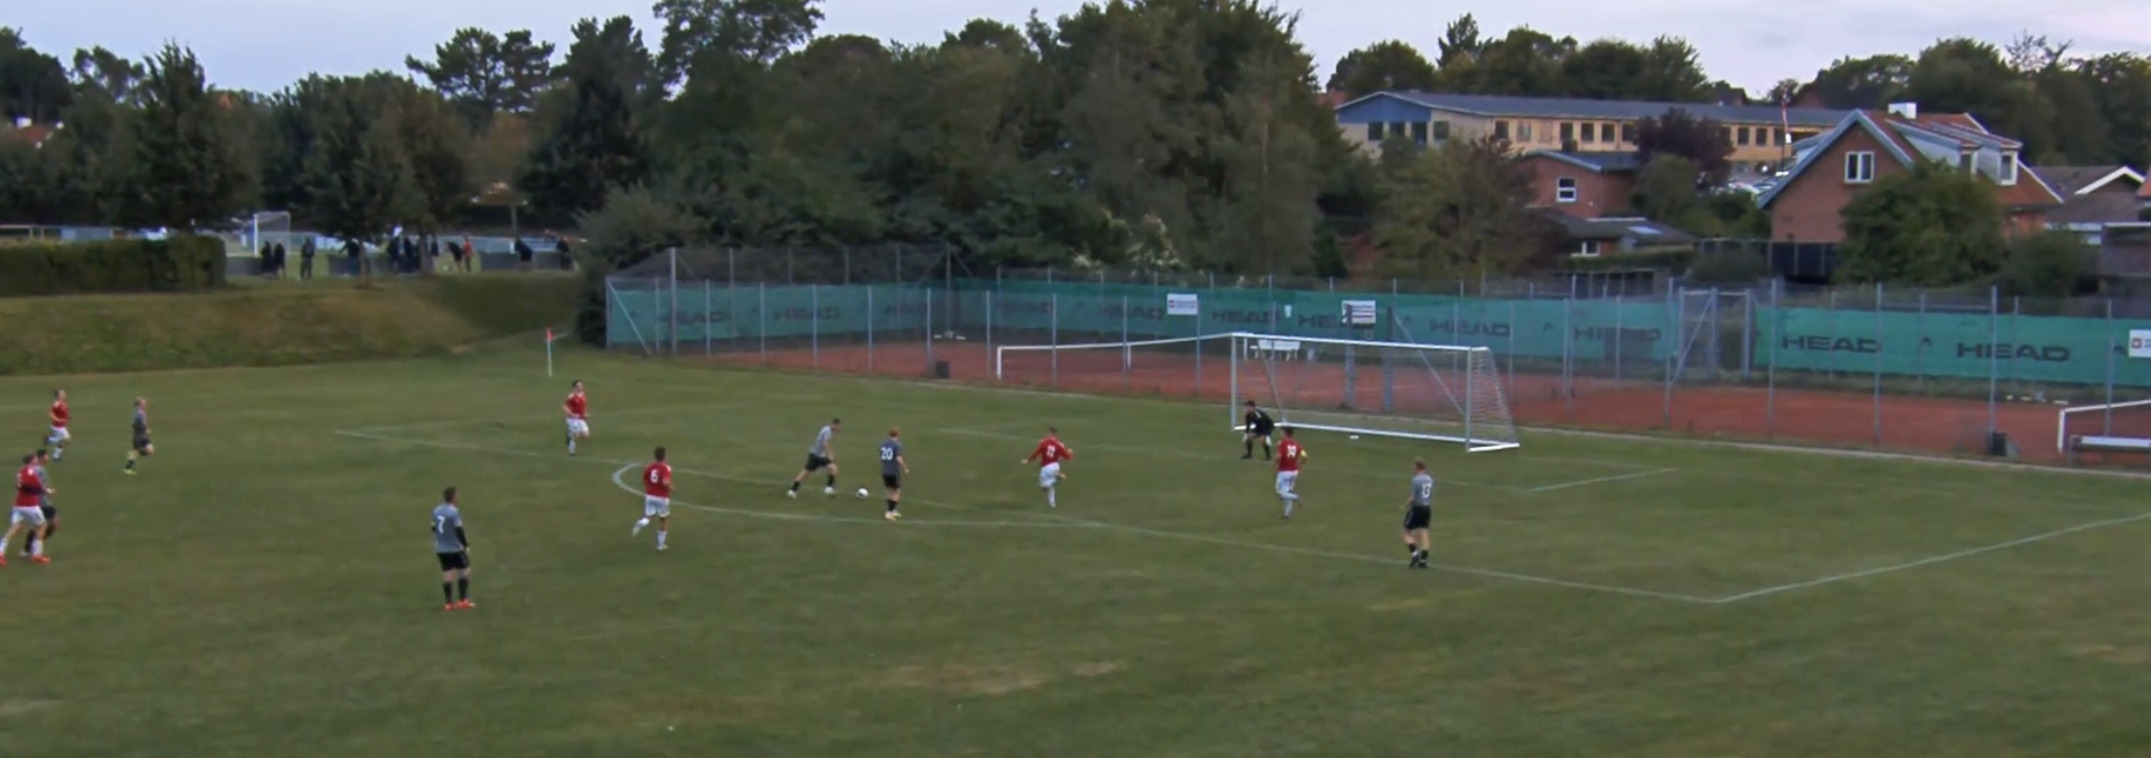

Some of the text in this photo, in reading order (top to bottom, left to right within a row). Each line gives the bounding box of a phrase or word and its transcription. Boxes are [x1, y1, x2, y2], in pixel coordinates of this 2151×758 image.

[1782, 336, 1882, 353] HEAD
[1957, 342, 2070, 361] HEAD
[880, 446, 894, 461] 20
[650, 469, 659, 483] 6
[437, 515, 446, 534] 7
